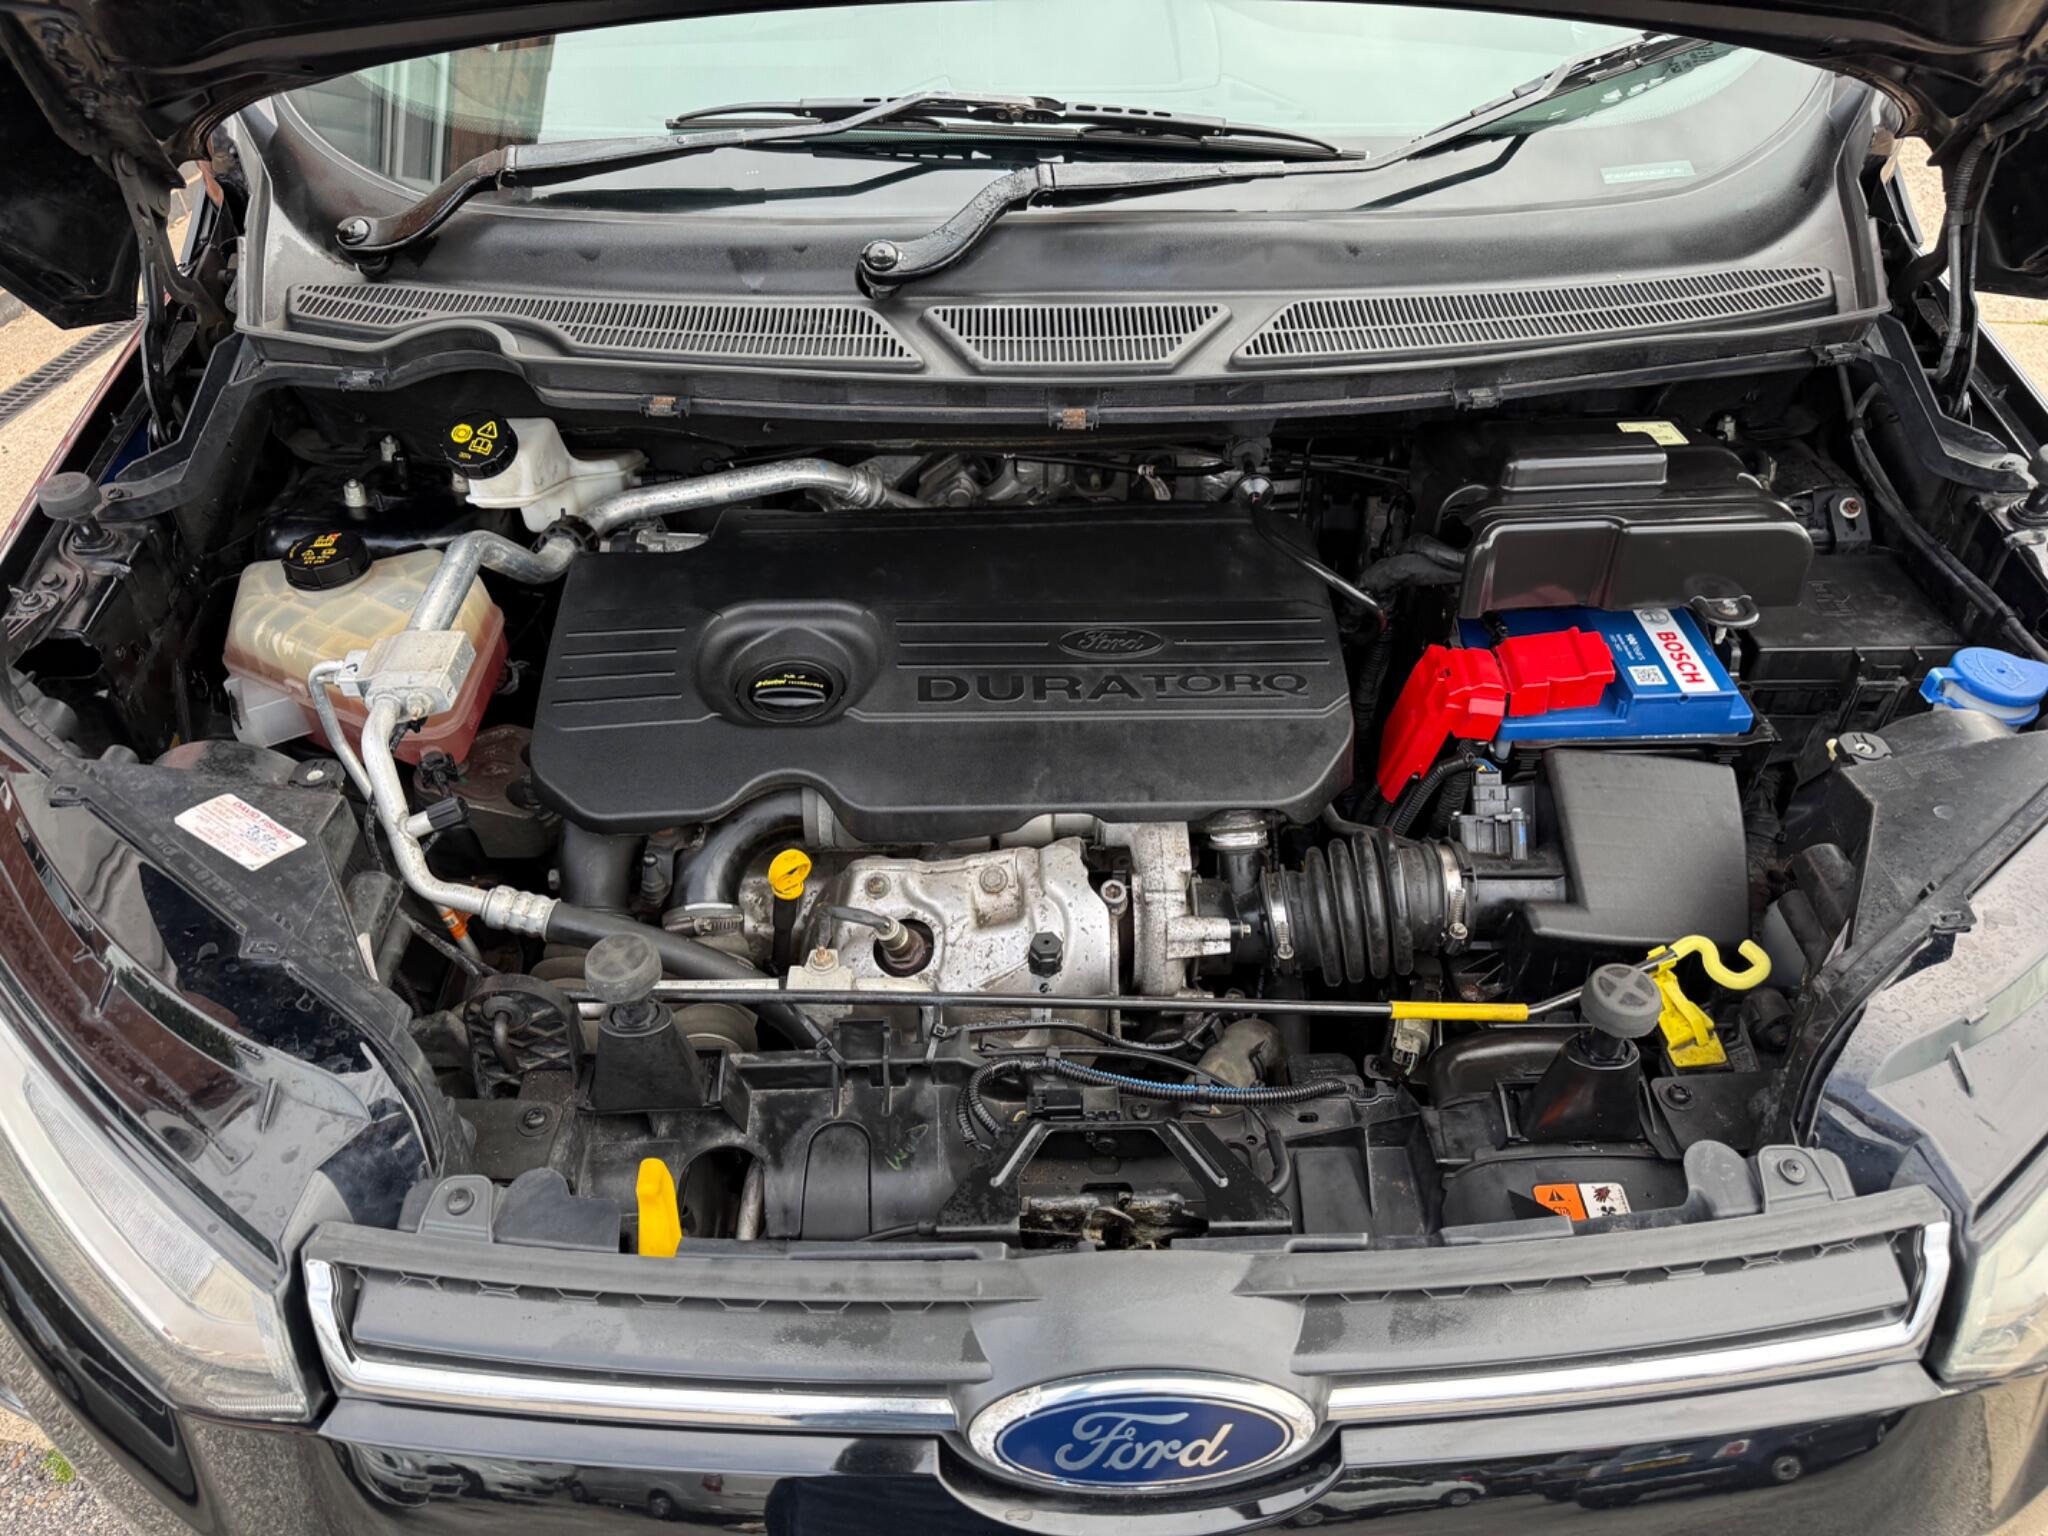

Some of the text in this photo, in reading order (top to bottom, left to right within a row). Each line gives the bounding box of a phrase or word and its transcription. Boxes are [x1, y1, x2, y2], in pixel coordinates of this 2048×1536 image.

[1078, 630, 1144, 651] Ford
[1656, 631, 1705, 684] BOSCH
[917, 672, 1309, 704] DURATORQ
[1054, 1411, 1234, 1471] Ford
